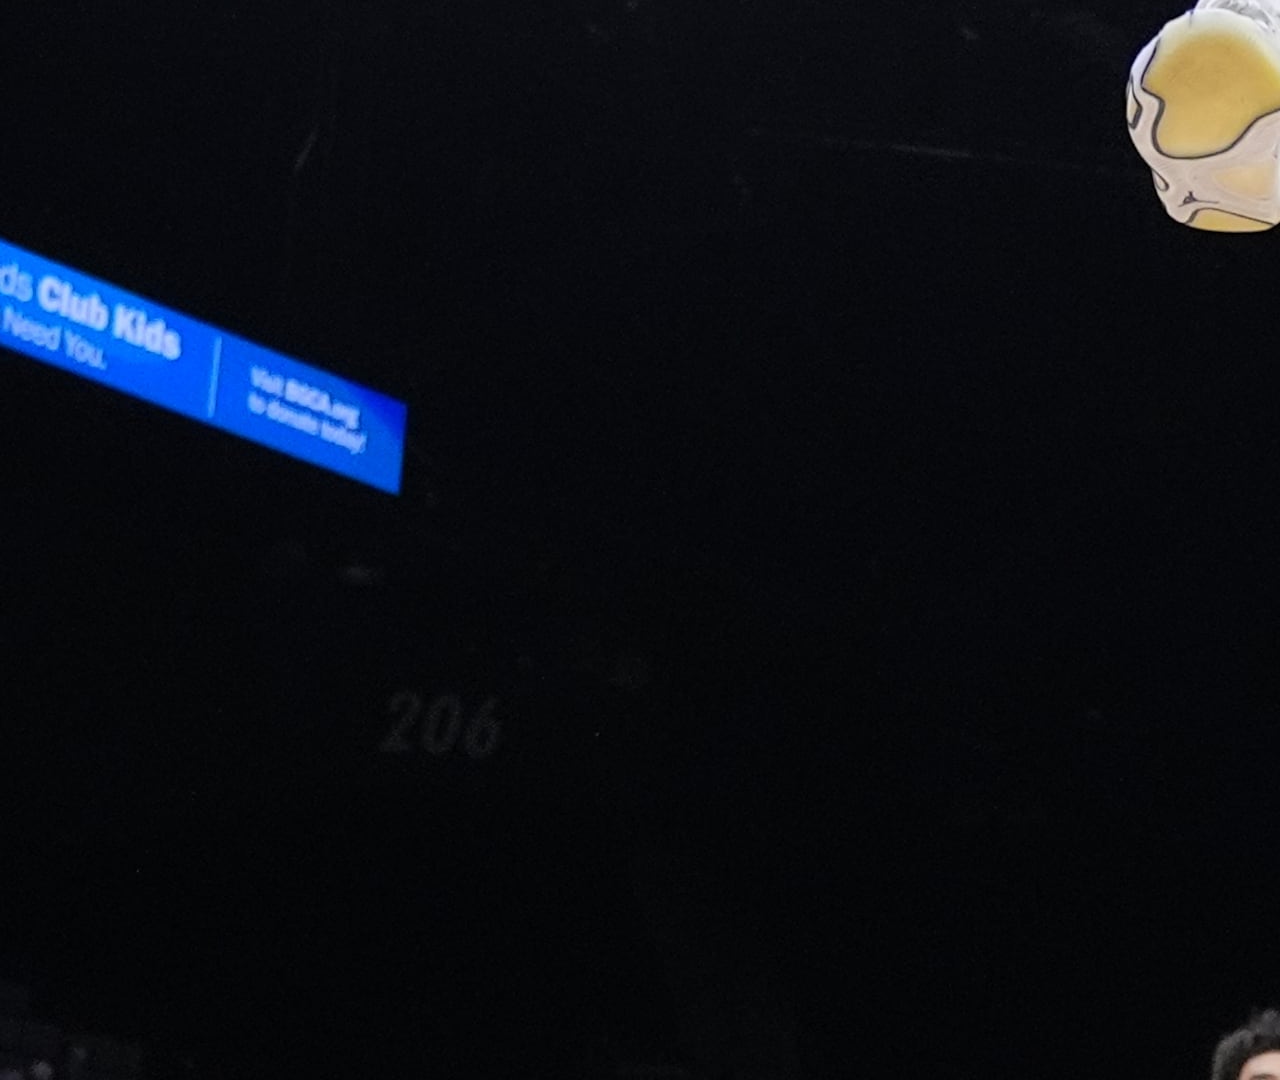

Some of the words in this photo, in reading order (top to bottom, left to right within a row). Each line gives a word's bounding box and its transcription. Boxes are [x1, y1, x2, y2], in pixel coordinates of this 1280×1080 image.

[36, 274, 109, 332] Club
[111, 302, 182, 361] Kids
[378, 690, 502, 760] 206
